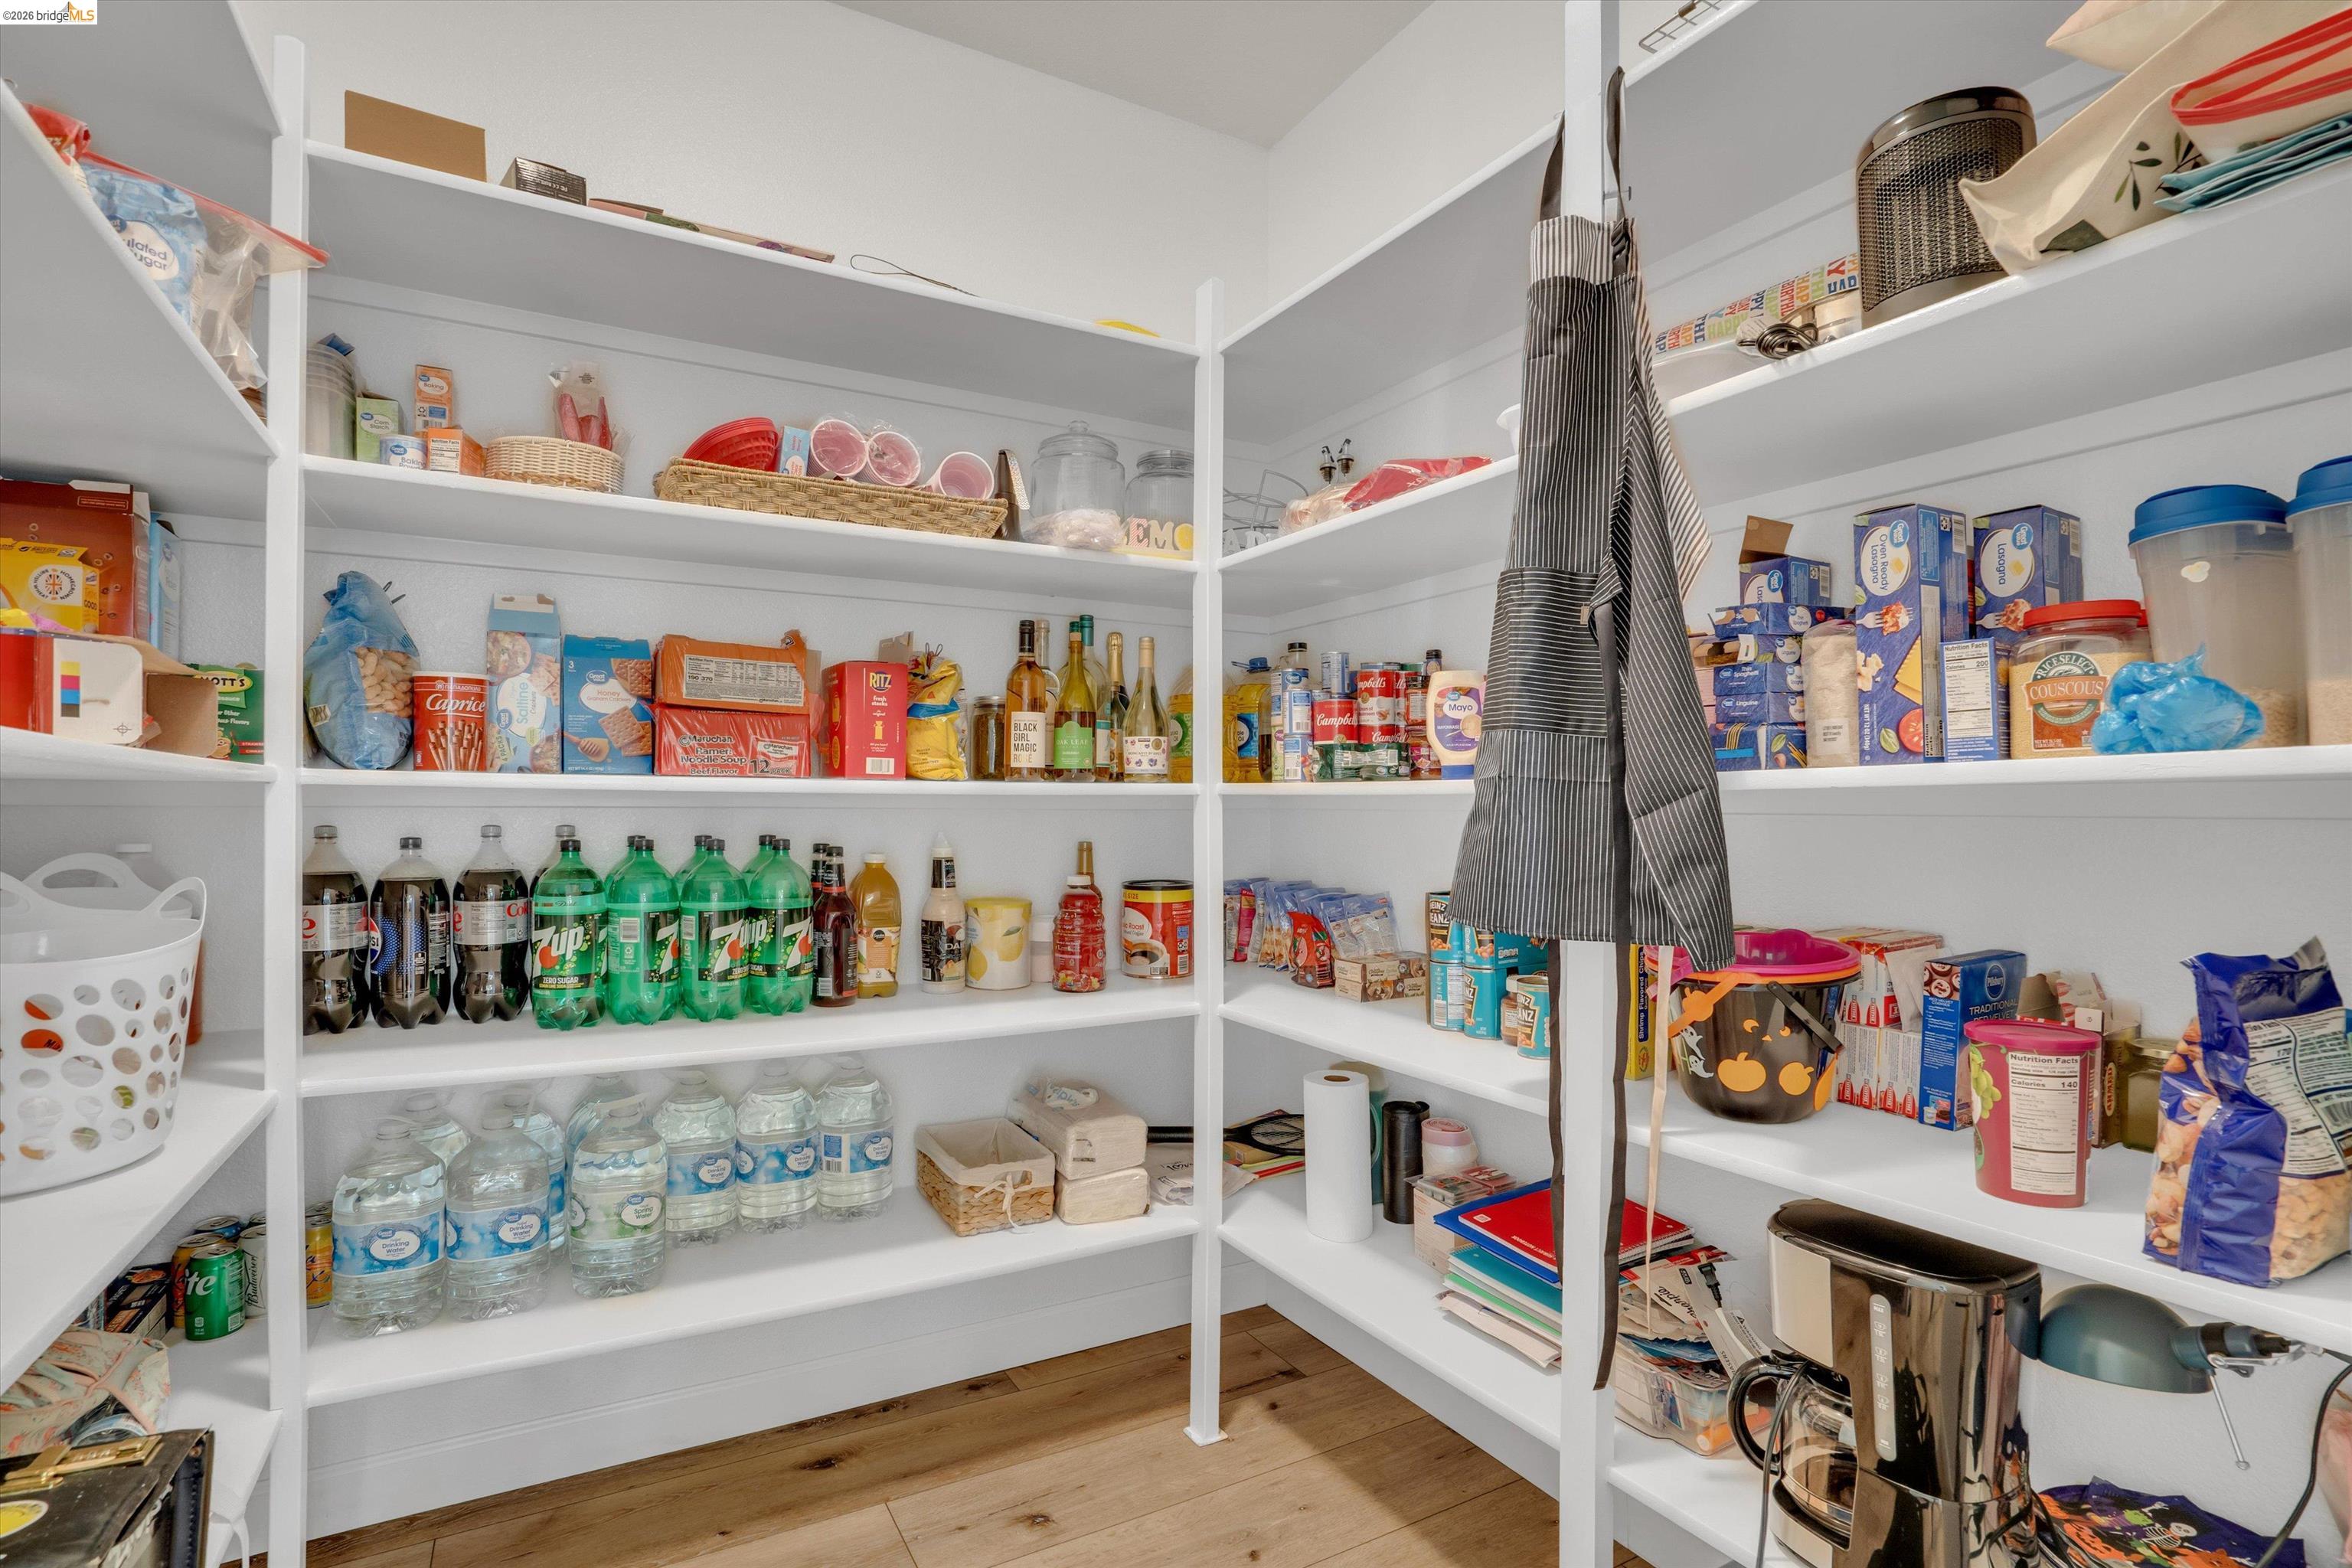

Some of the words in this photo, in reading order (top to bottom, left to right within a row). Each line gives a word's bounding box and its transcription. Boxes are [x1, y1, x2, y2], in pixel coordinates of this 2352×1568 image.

[1880, 534, 1888, 559] Oven
[1870, 544, 1879, 583] Lasagna
[1997, 543, 2007, 586] Lasagna
[1880, 561, 1889, 590] Ready
[870, 673, 892, 688] RITZ
[2030, 681, 2104, 700] COUSCOUS
[426, 693, 486, 713] Caprice
[517, 682, 528, 724] Saltine
[1449, 704, 1473, 713] Mayo
[1014, 723, 1037, 732] BLACK
[691, 734, 733, 743] Maruchan
[1013, 733, 1030, 742] GIRL
[498, 735, 507, 757] PACKS
[695, 746, 732, 755] Ramen
[1013, 743, 1037, 753] MAGIC
[681, 755, 720, 764] Noodle
[720, 756, 747, 765] Soup
[1013, 753, 1033, 763] ROÉ
[750, 760, 770, 774] 12
[532, 926, 584, 978] 7up
[1969, 998, 2019, 1016] TRADITIONAL
[1990, 1009, 2014, 1021] VELVET
[2011, 1054, 2053, 1063] Nutrition
[2011, 1079, 2046, 1087] Calories
[634, 1207, 653, 1216] Spring
[509, 1223, 534, 1232] Drinking
[246, 1255, 260, 1308] Budweiser
